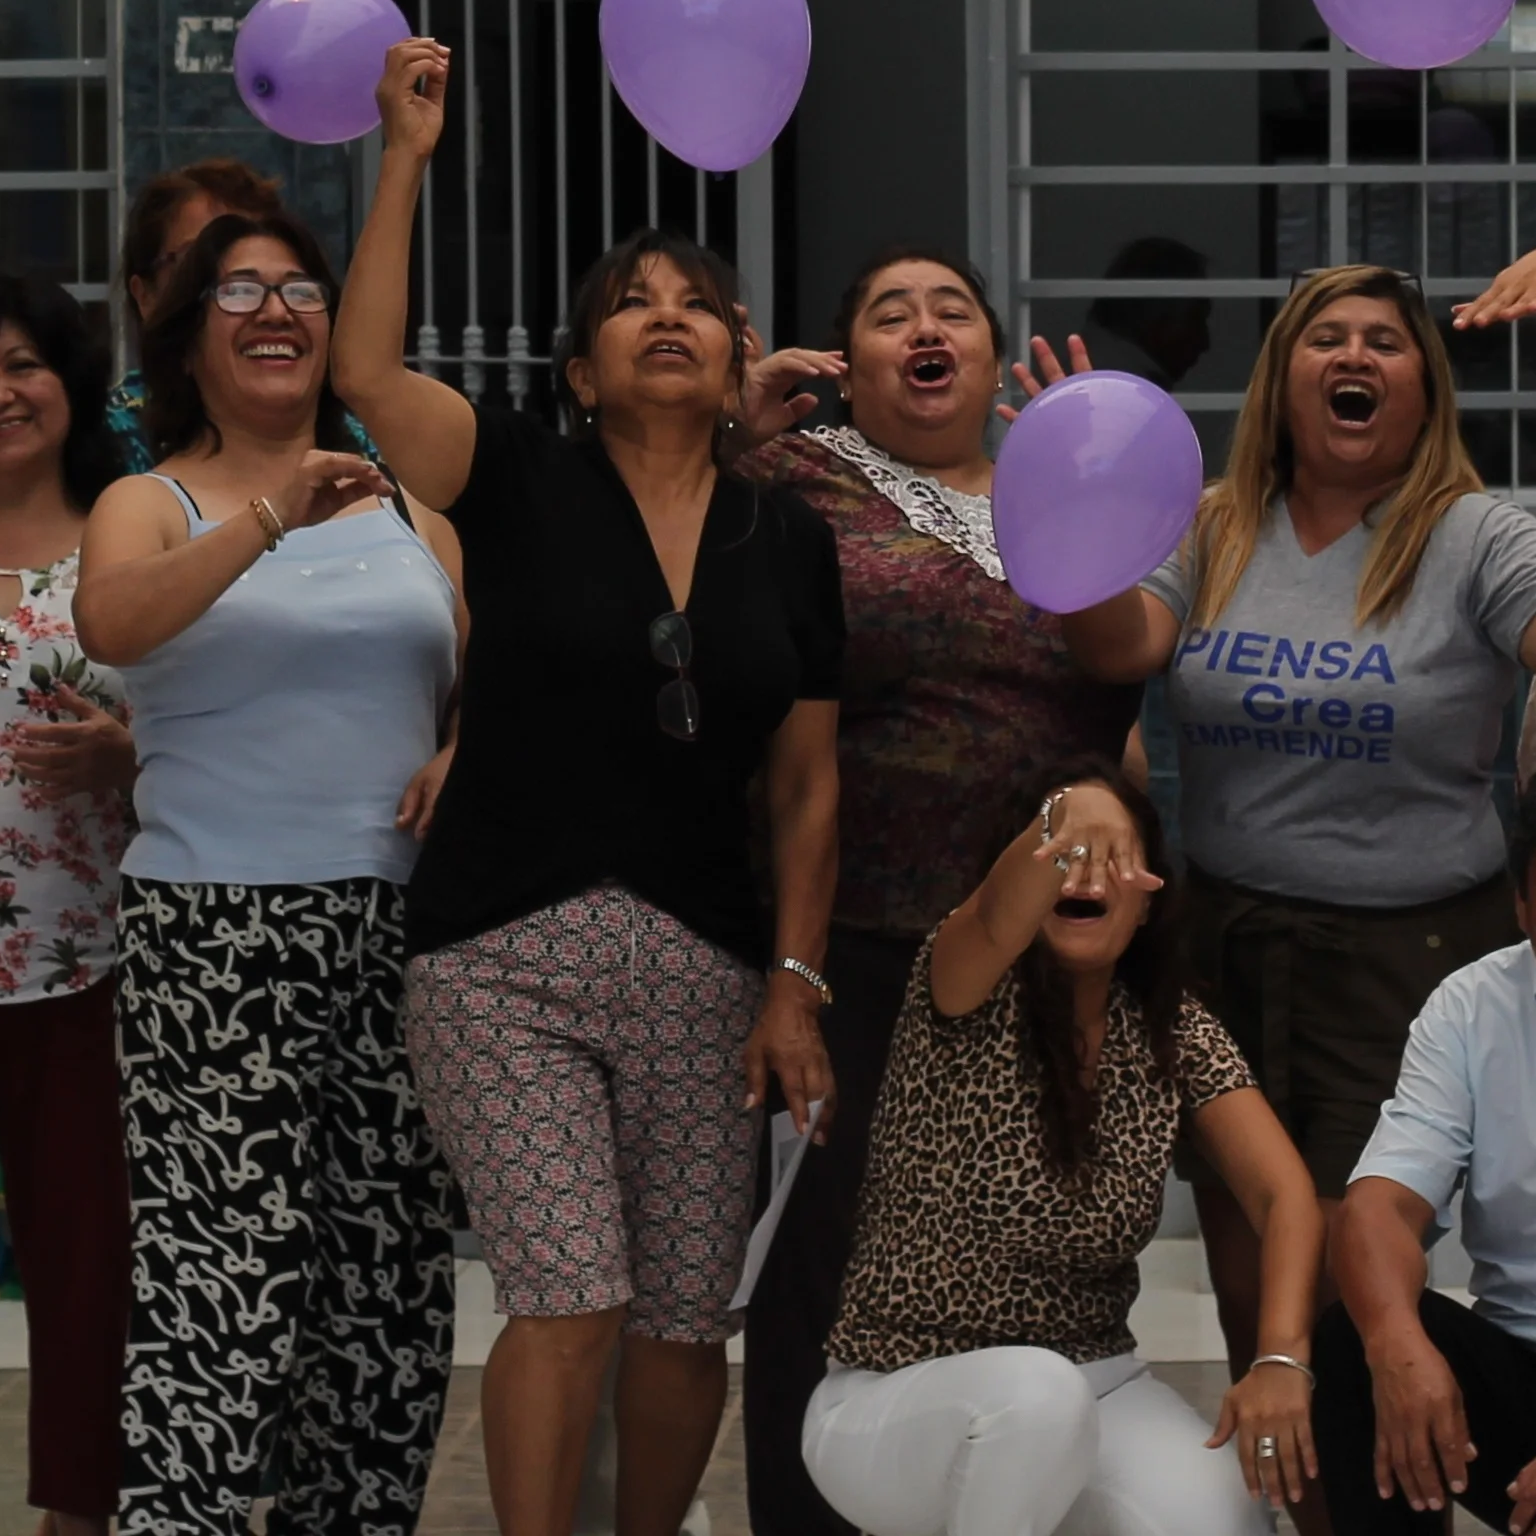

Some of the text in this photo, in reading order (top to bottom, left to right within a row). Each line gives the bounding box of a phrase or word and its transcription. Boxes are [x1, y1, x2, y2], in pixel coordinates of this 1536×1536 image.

[1176, 629, 1394, 683] PIENSA
[1242, 683, 1395, 734] Crea
[1183, 724, 1391, 763] EMPRENDE
